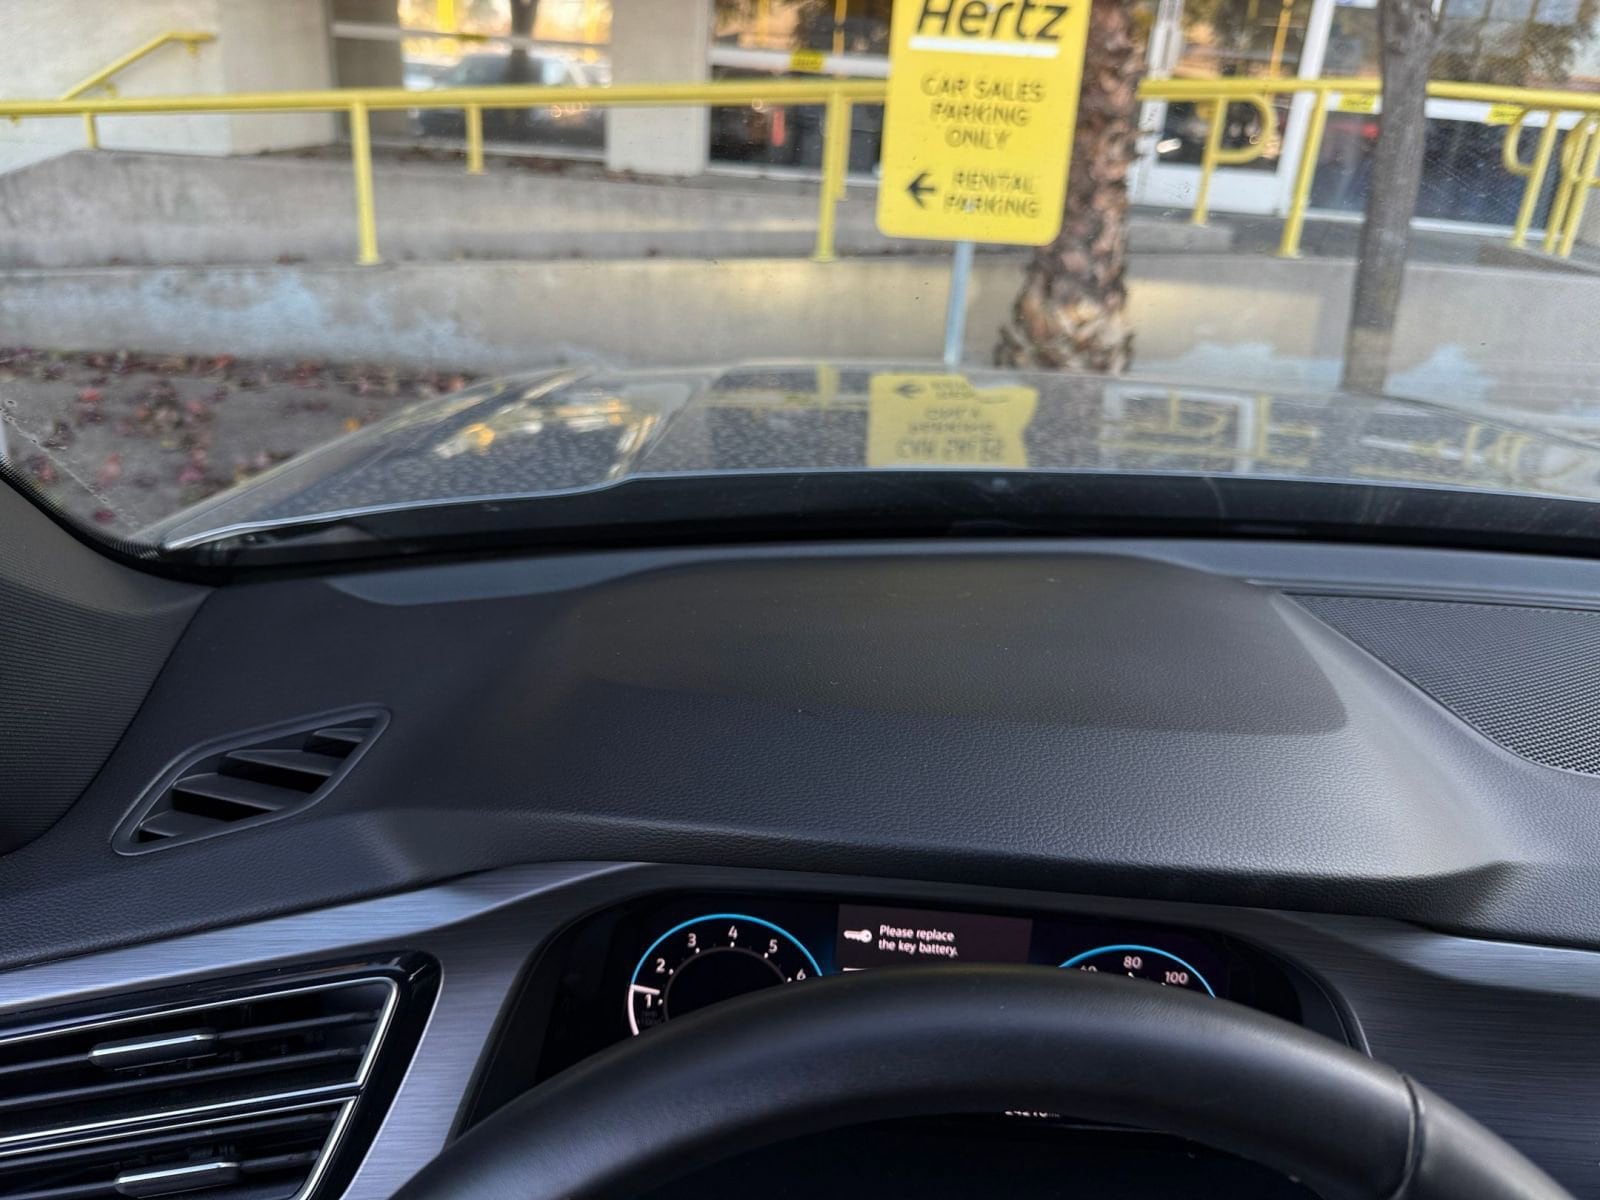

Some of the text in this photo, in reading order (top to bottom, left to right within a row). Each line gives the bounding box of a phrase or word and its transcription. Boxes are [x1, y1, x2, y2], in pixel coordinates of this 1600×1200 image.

[917, 0, 1069, 40] Hertz
[921, 75, 1046, 102] CAR SALES
[931, 102, 1030, 125] PARKING
[945, 129, 1012, 150] ONLY
[952, 171, 1035, 194] RENTAL
[945, 194, 1040, 217] PARKING
[687, 933, 697, 947] 3
[728, 925, 738, 939] 4
[879, 925, 955, 942] Please replace
[768, 939, 778, 953] 5
[878, 939, 959, 958] the key battery.
[656, 958, 666, 973] 2
[1123, 955, 1143, 969] 80
[796, 969, 807, 981] 6
[1165, 971, 1189, 984] 100
[644, 994, 652, 1008] 1
